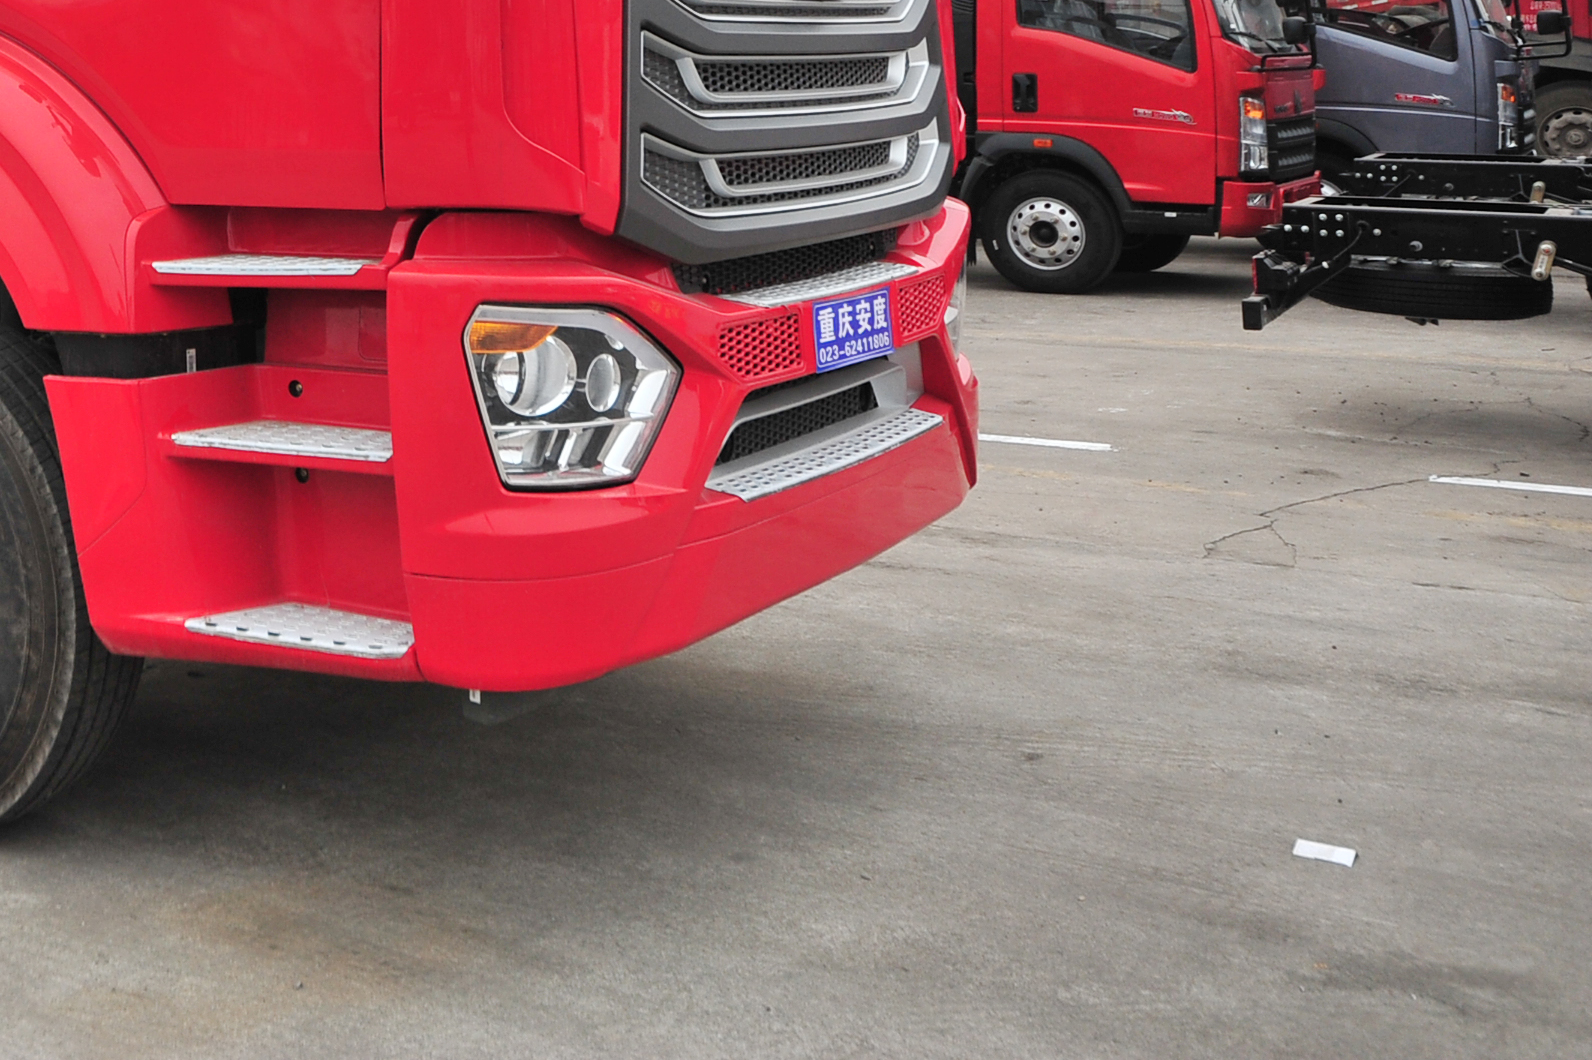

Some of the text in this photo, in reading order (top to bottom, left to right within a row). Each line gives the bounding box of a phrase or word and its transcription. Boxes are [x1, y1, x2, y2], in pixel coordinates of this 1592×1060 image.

[818, 295, 887, 343] 重庆安度
[819, 331, 890, 363] 023-62411806
